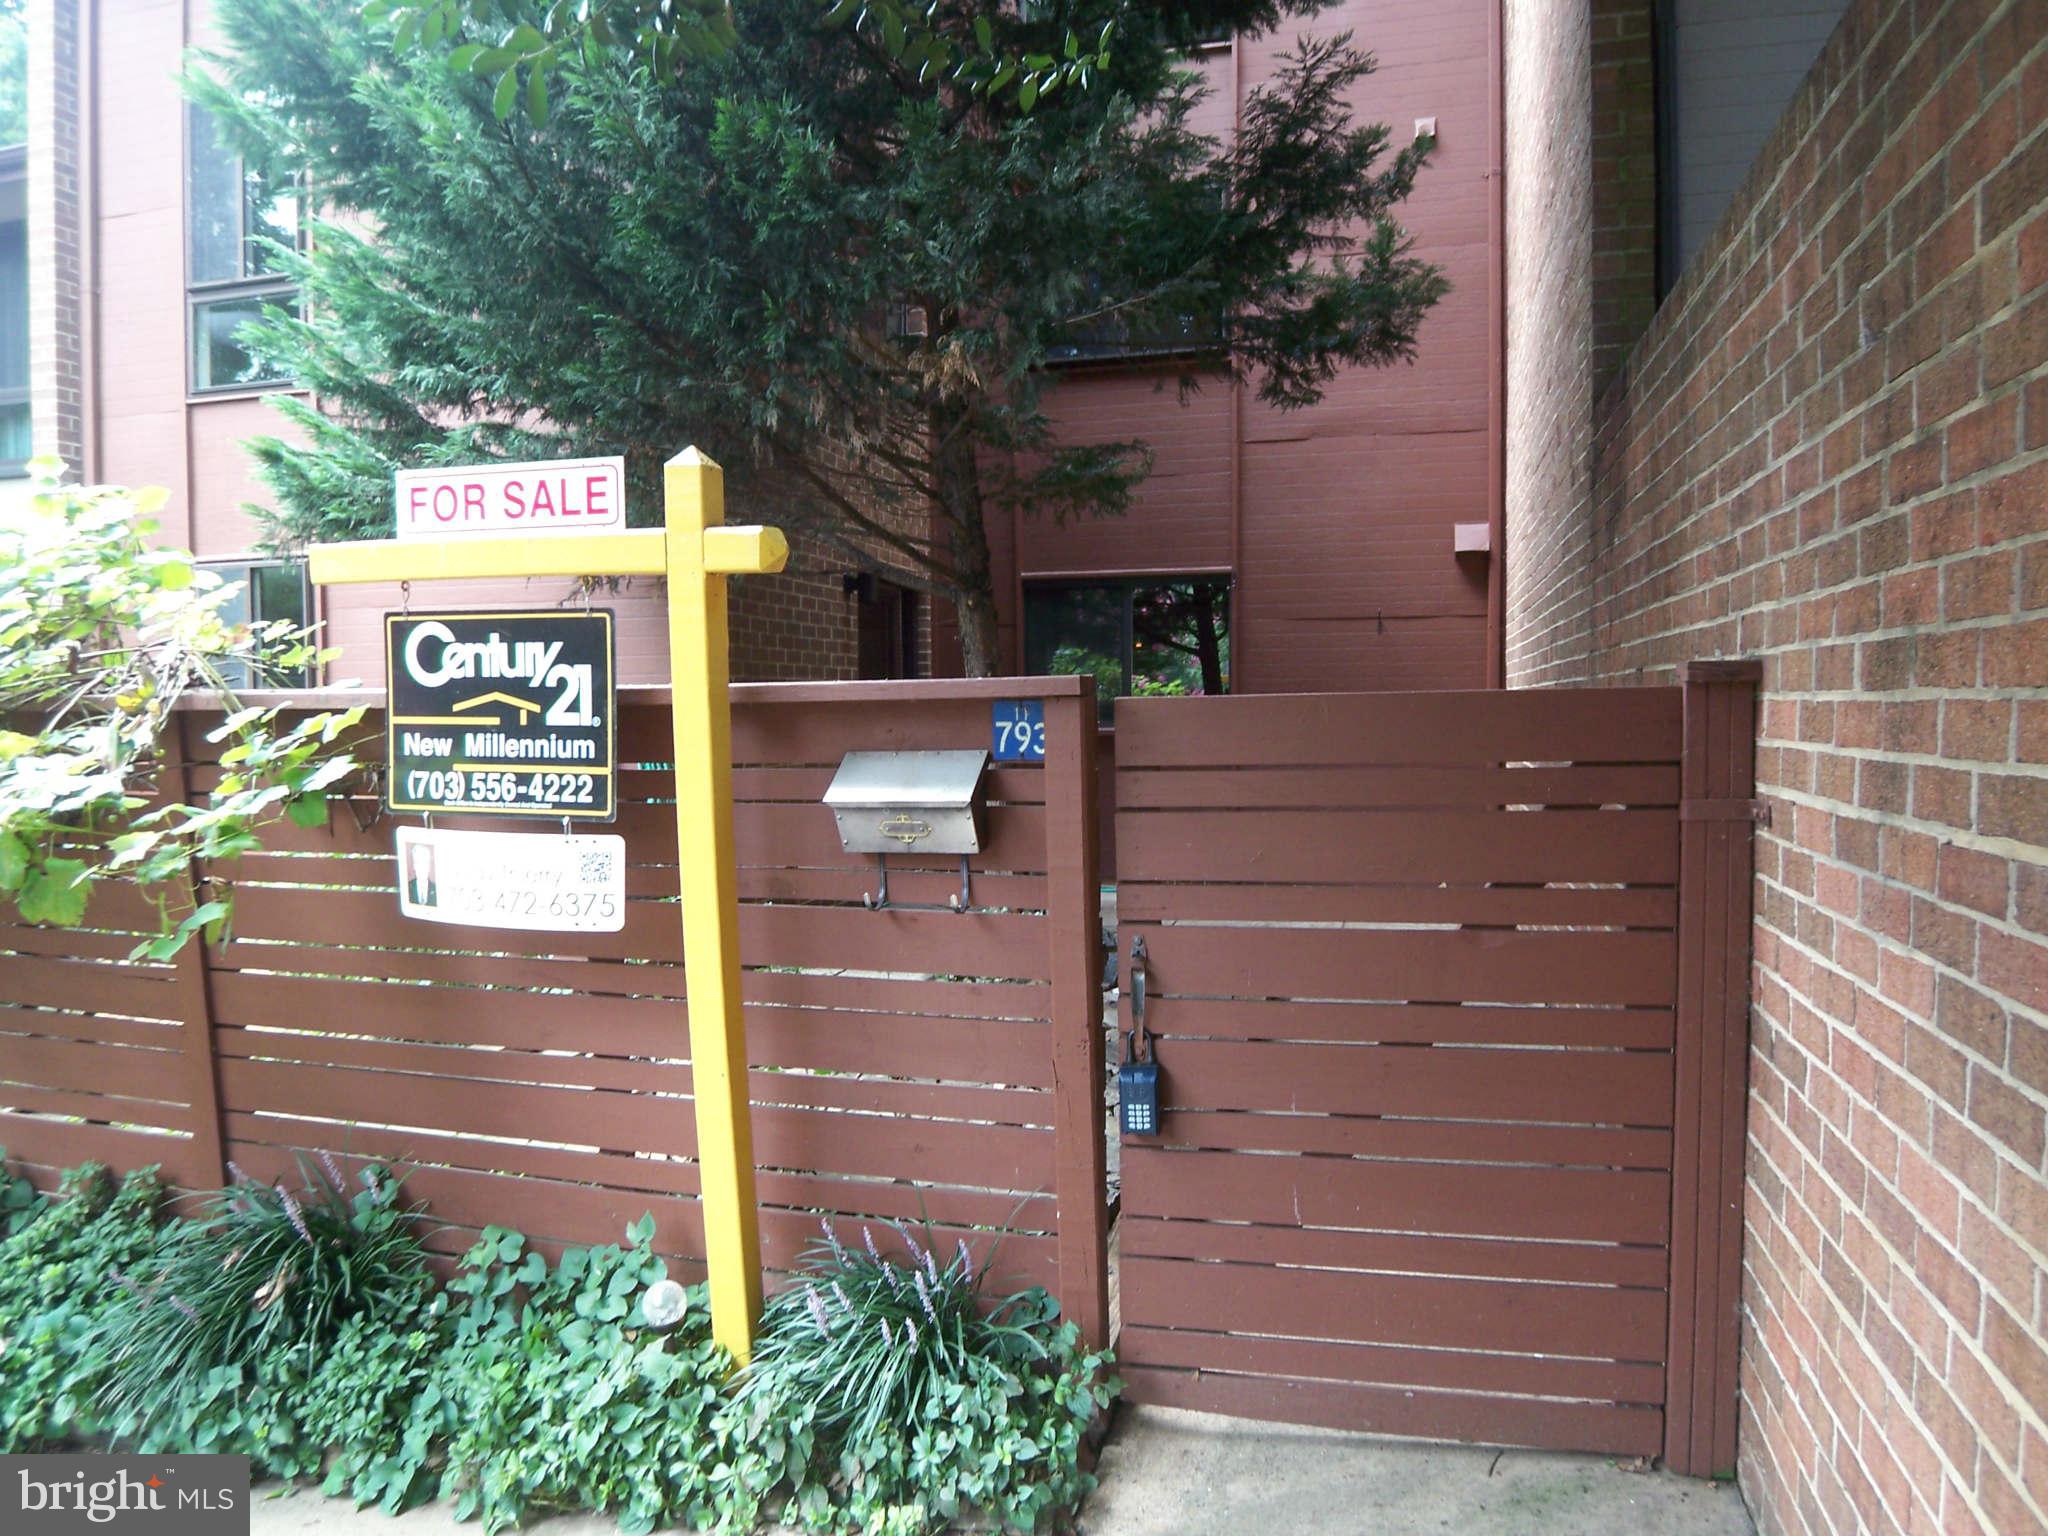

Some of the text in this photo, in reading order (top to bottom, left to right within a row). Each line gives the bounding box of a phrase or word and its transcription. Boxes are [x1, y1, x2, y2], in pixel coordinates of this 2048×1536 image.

[410, 476, 609, 523] FOR SALE
[404, 621, 593, 727] Century 21
[403, 732, 596, 759] New Millennium
[407, 769, 594, 804] (703) 556-4222
